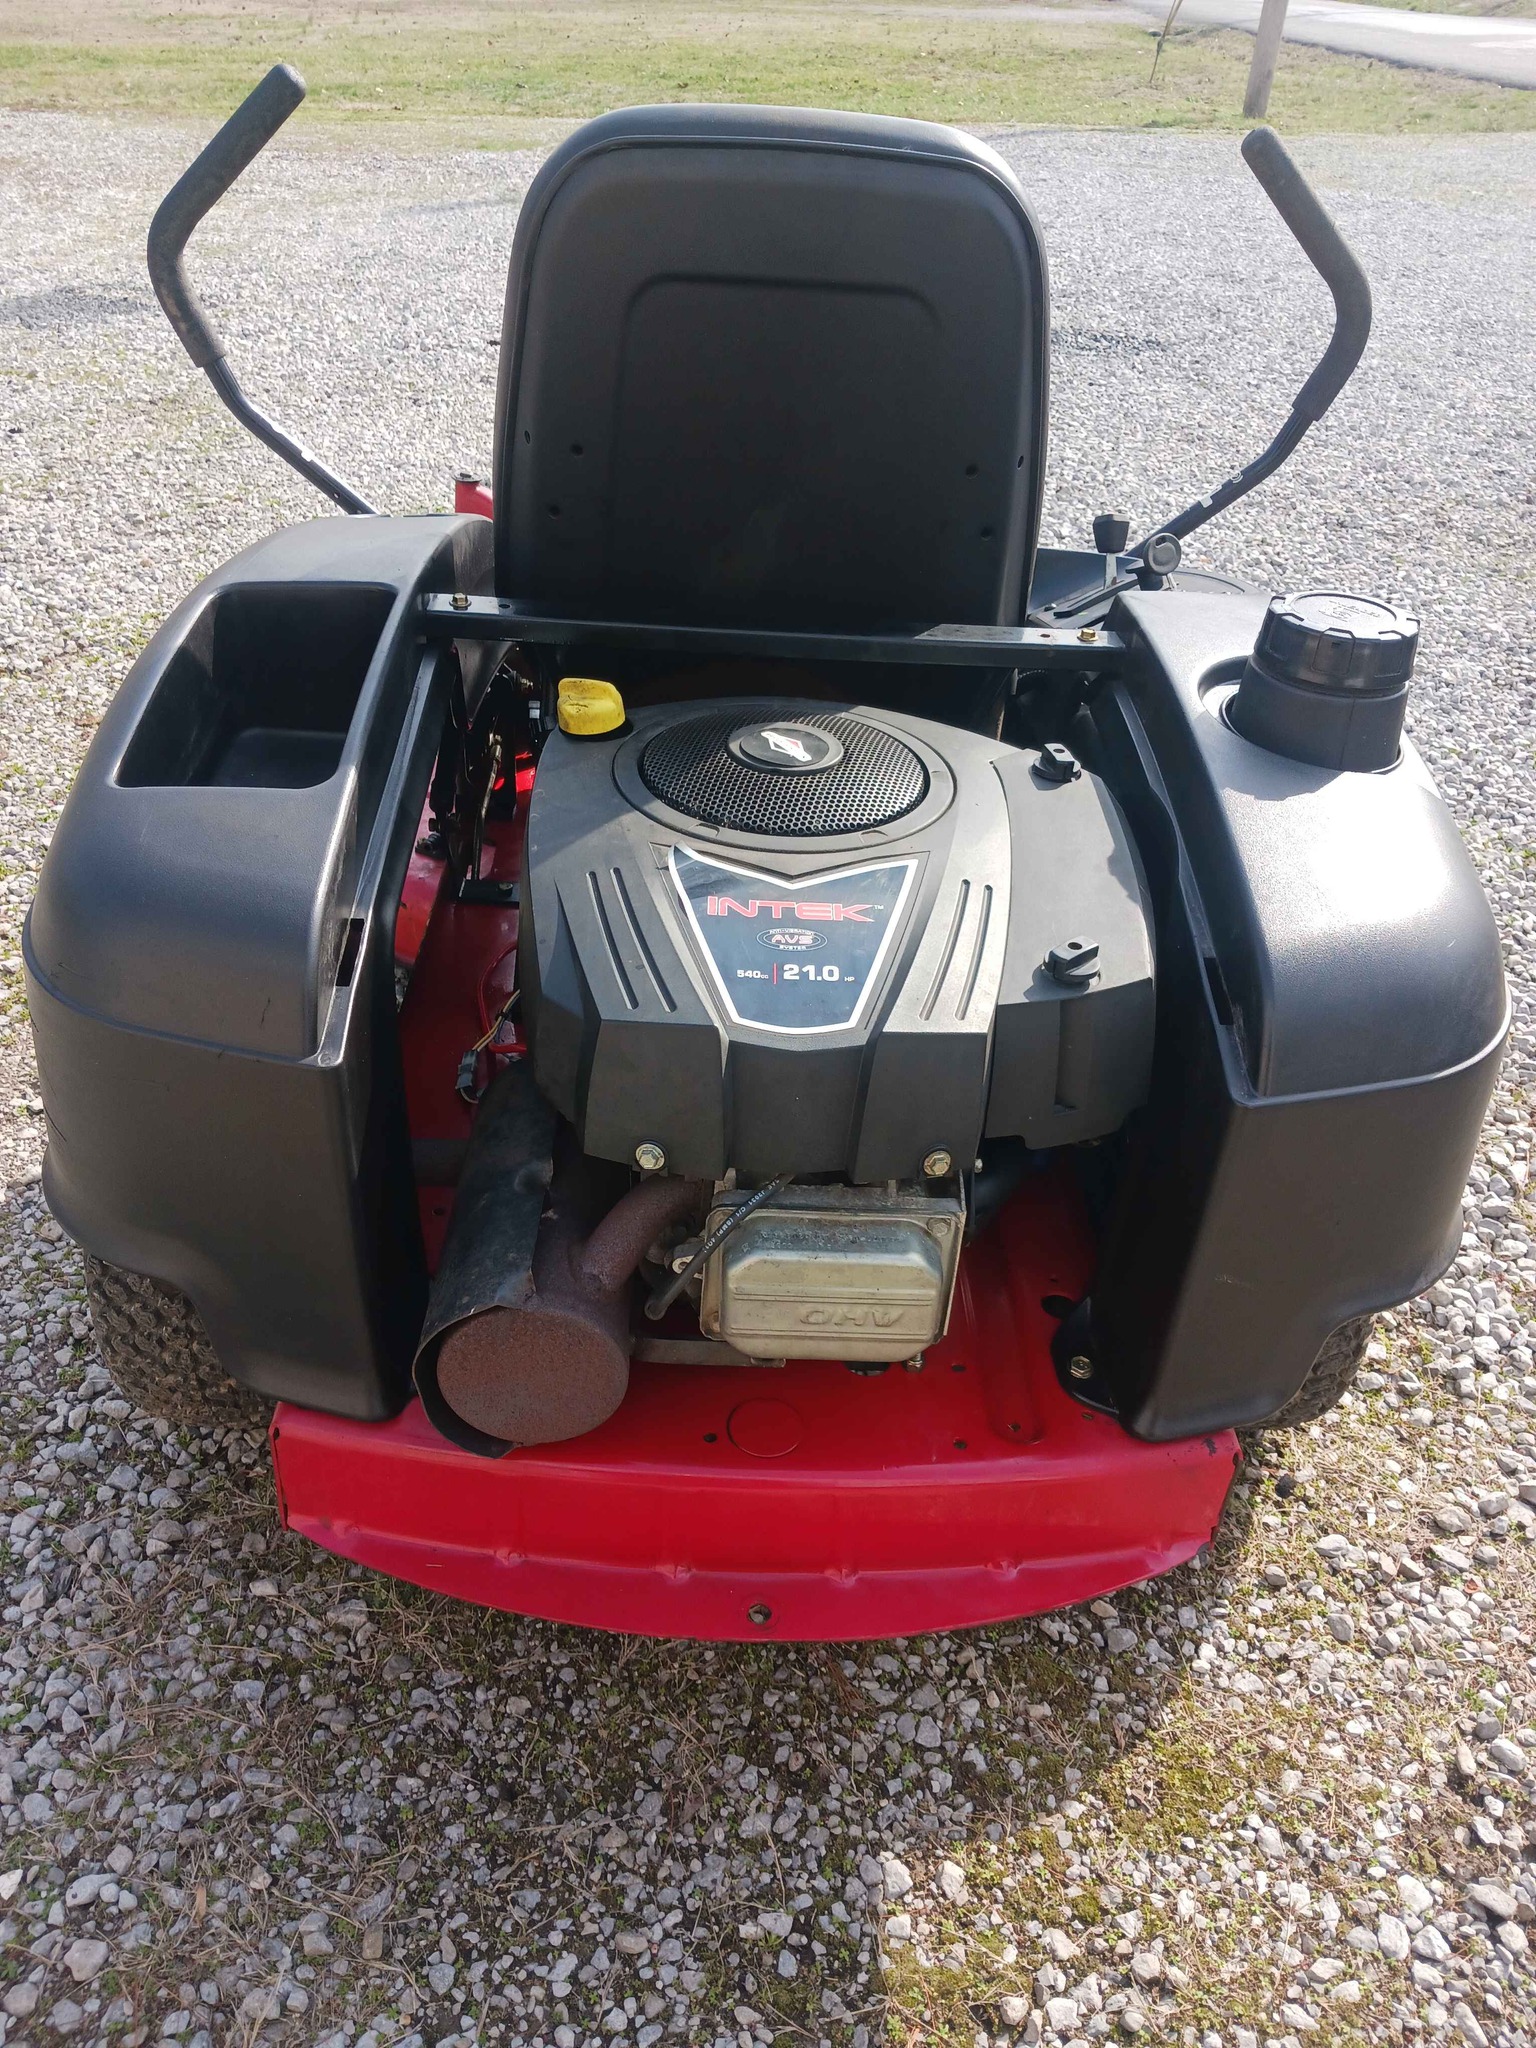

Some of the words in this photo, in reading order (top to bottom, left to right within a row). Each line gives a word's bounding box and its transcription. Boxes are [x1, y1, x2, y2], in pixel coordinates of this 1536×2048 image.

[706, 895, 875, 923] INTEK
[771, 934, 814, 945] AVS
[782, 964, 840, 982] 21.0
